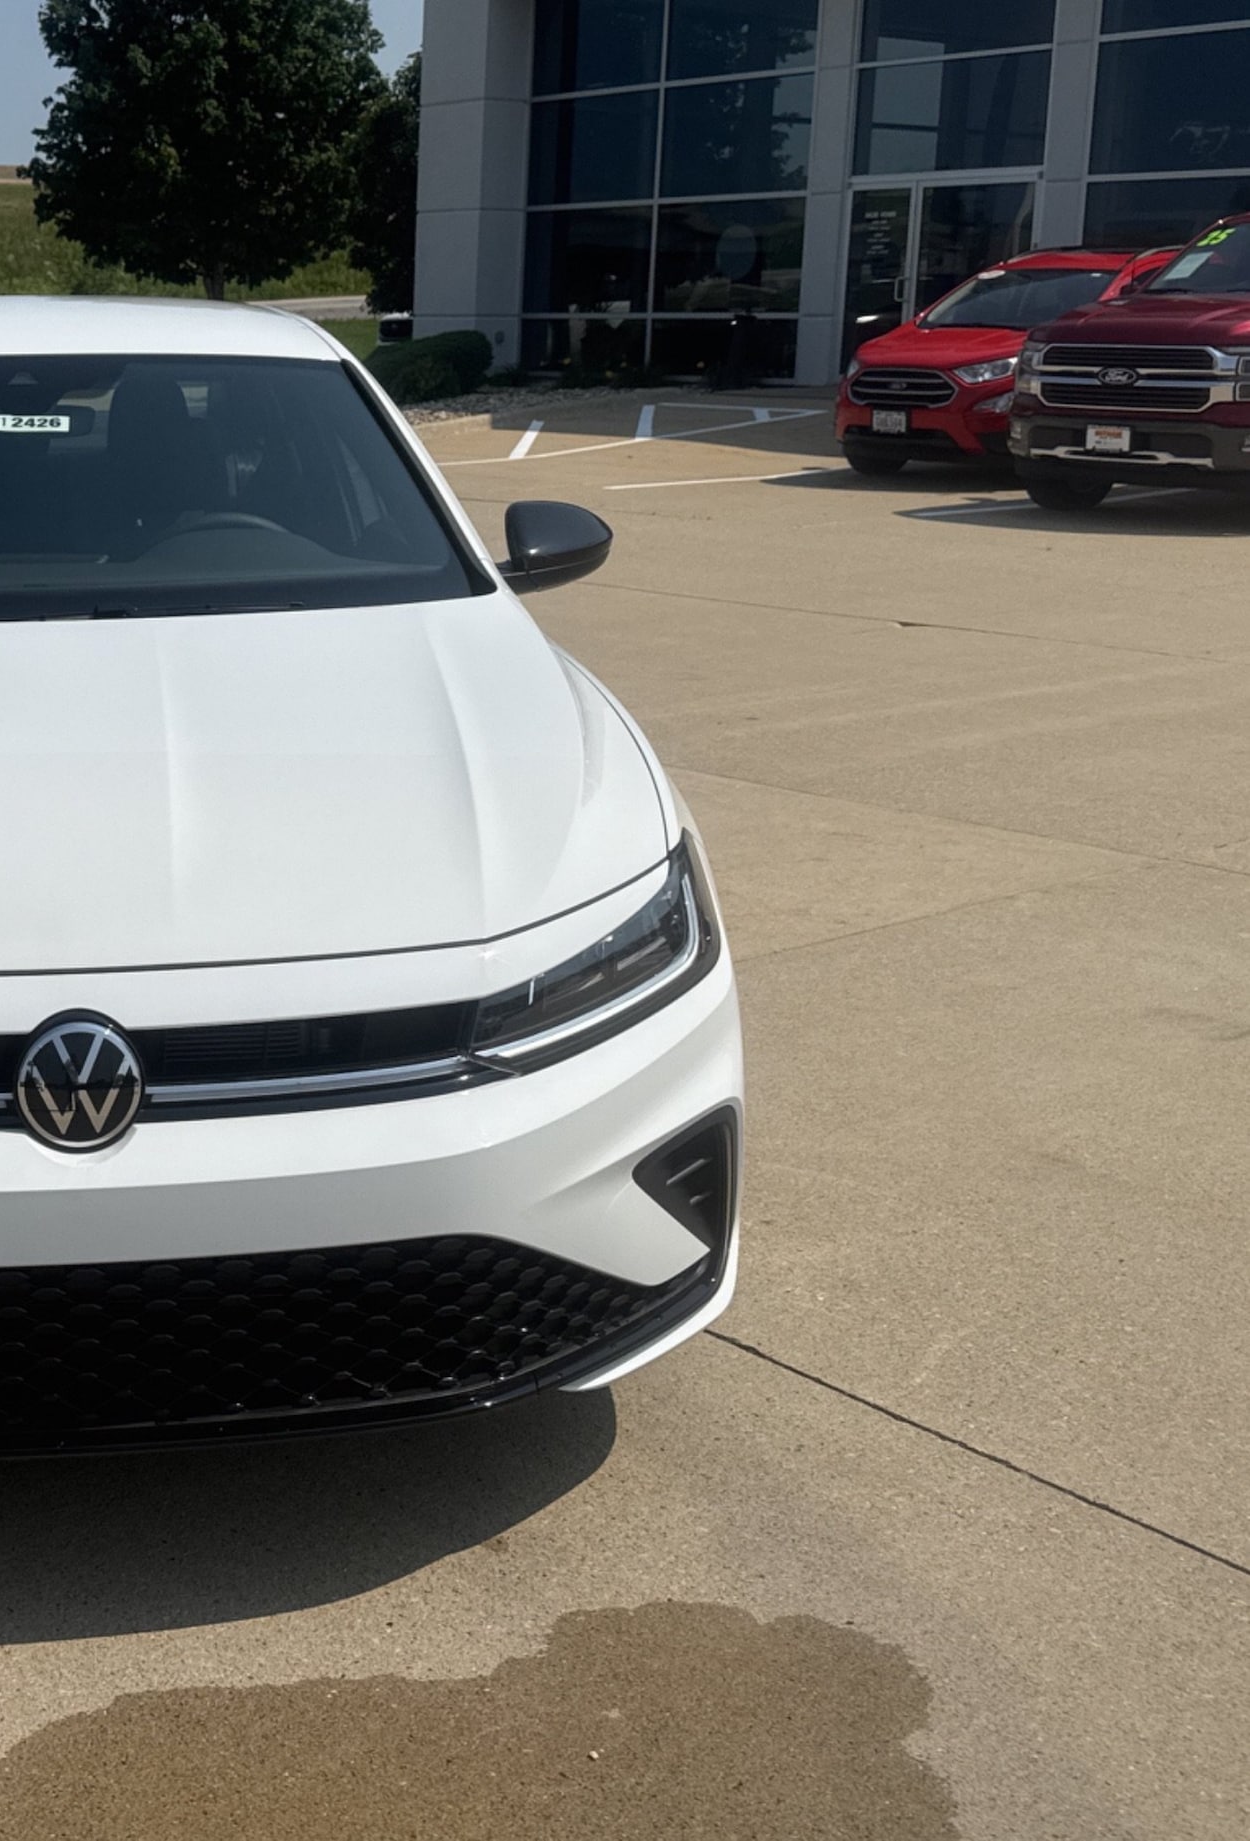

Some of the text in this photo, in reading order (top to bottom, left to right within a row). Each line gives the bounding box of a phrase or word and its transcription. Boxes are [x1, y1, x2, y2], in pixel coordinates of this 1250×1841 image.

[1196, 228, 1236, 247] 25
[11, 417, 62, 428] 2426
[18, 1023, 142, 1148] VW
